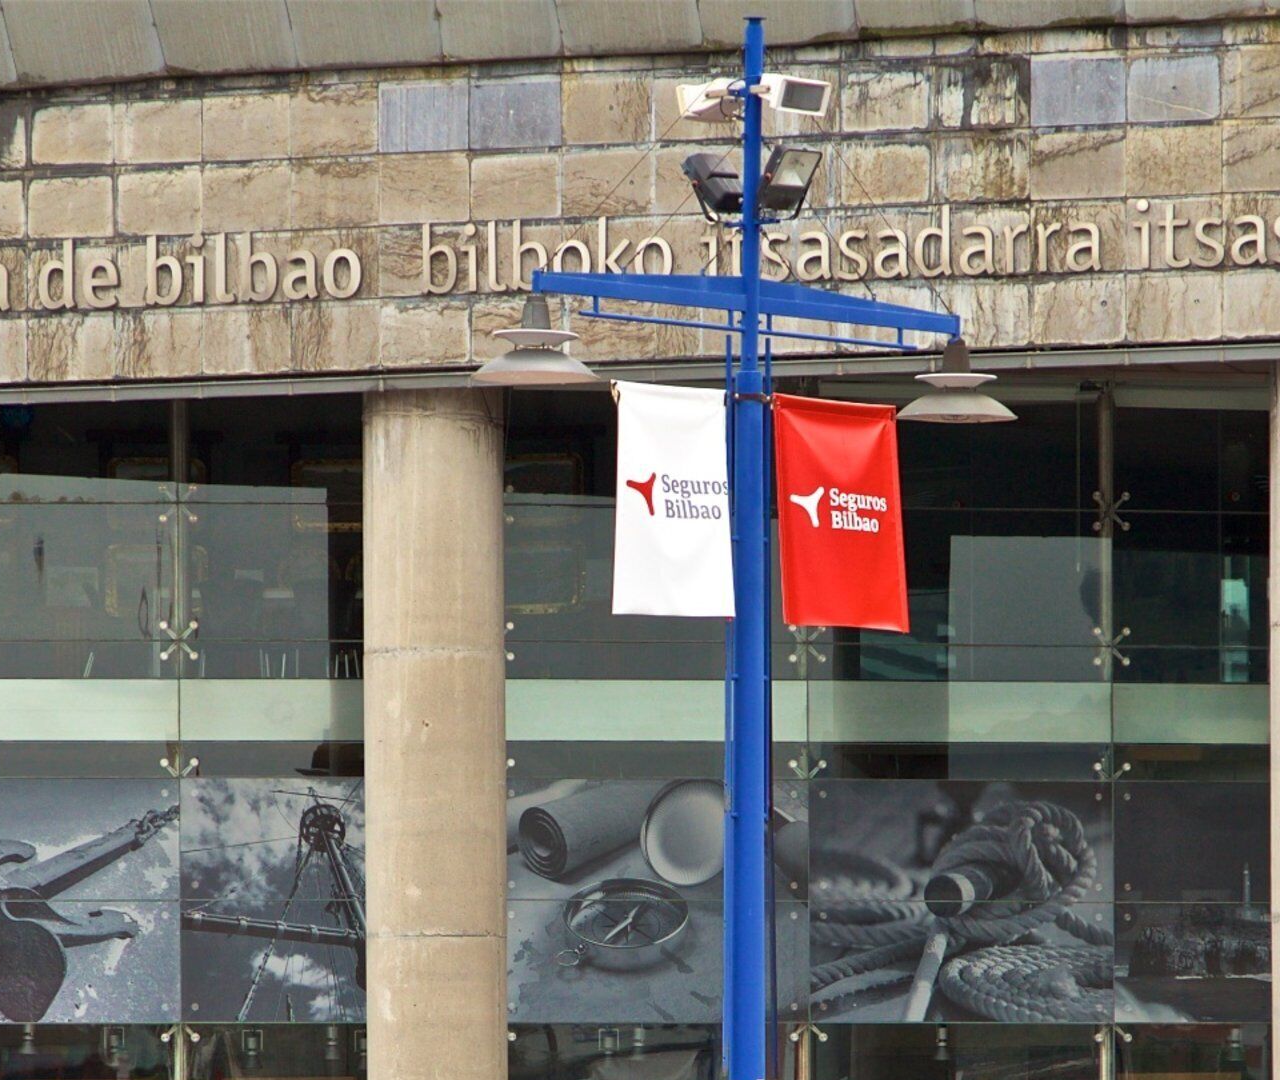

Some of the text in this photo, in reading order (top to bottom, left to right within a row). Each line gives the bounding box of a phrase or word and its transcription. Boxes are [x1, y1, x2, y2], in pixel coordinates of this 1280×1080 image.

[37, 237, 120, 310] de
[146, 231, 364, 306] bilbao
[420, 215, 674, 294] bilboko
[661, 474, 728, 499] Seguros
[664, 499, 721, 520] Bilbao
[829, 487, 888, 512] Seguros
[830, 510, 880, 534] Bilbao
